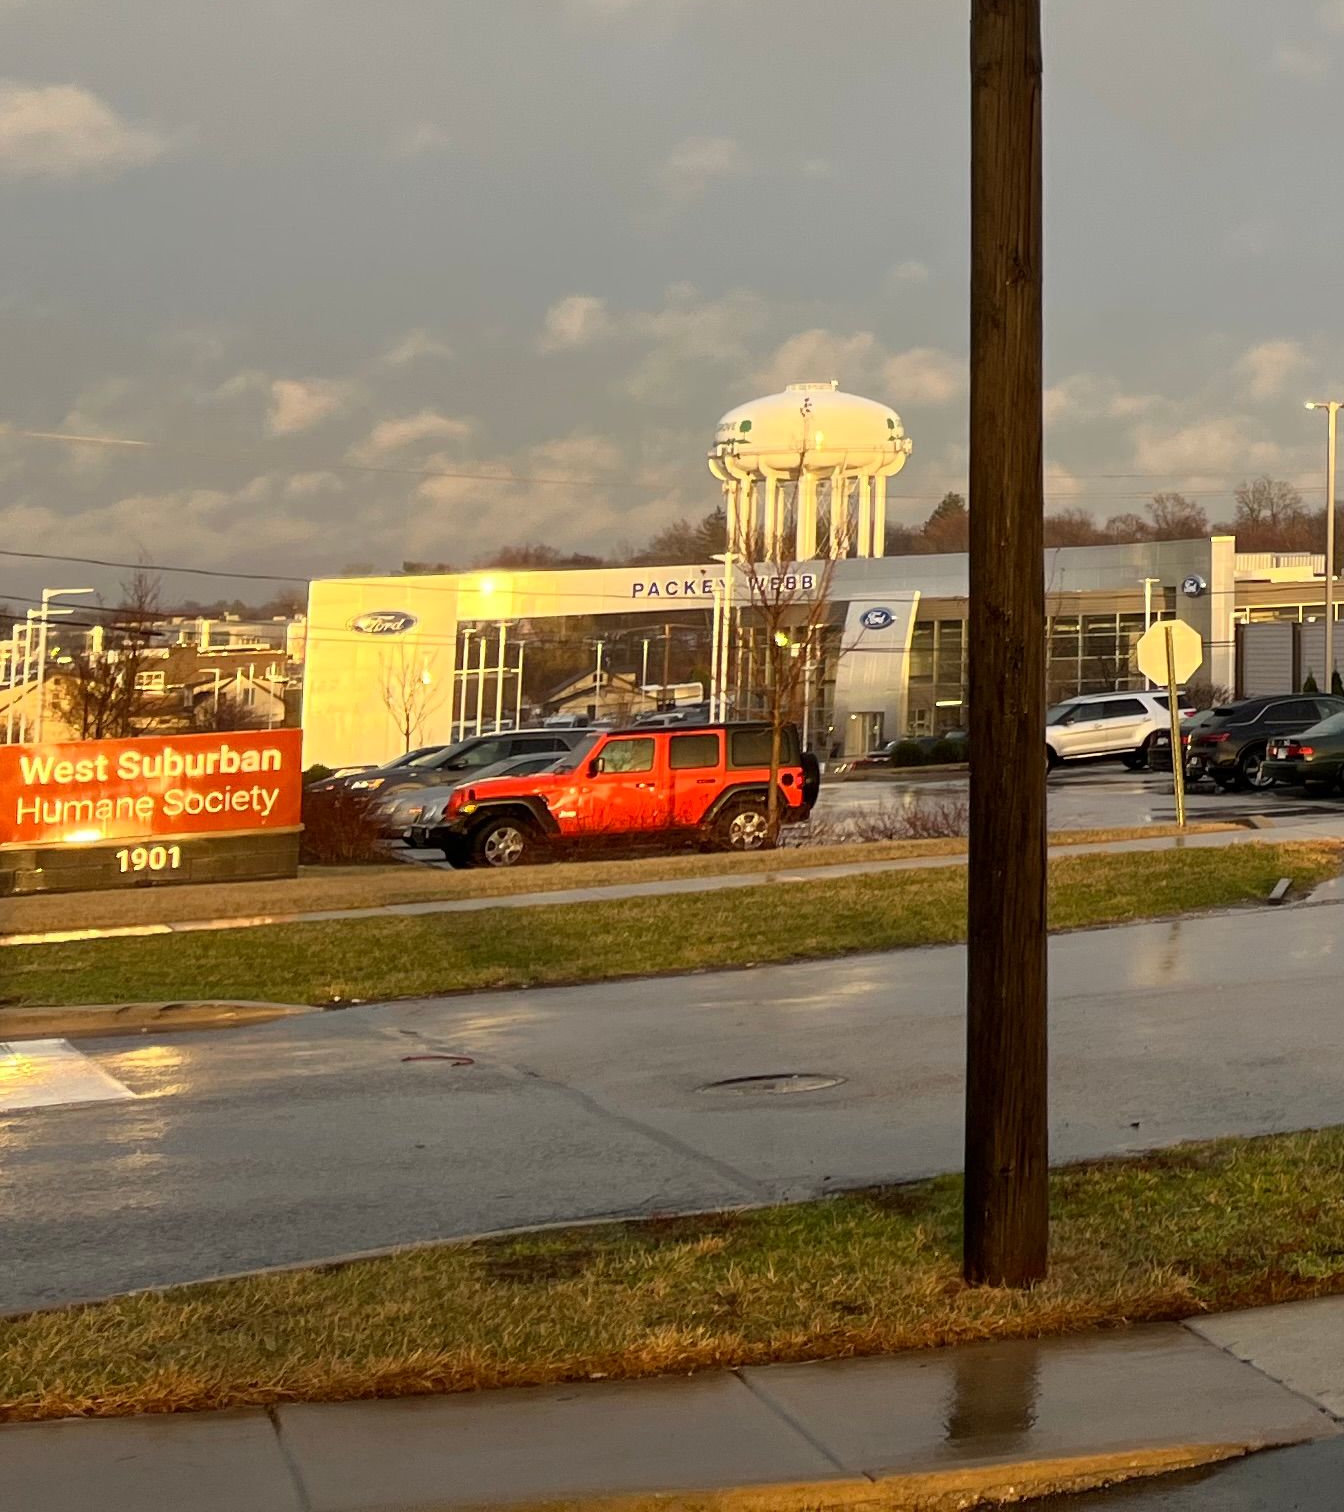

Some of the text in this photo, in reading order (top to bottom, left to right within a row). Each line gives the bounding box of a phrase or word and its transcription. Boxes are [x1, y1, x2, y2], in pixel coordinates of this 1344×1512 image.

[20, 744, 283, 785] West Suburban
[15, 784, 280, 825] Humane Society
[115, 845, 182, 873] 1901
